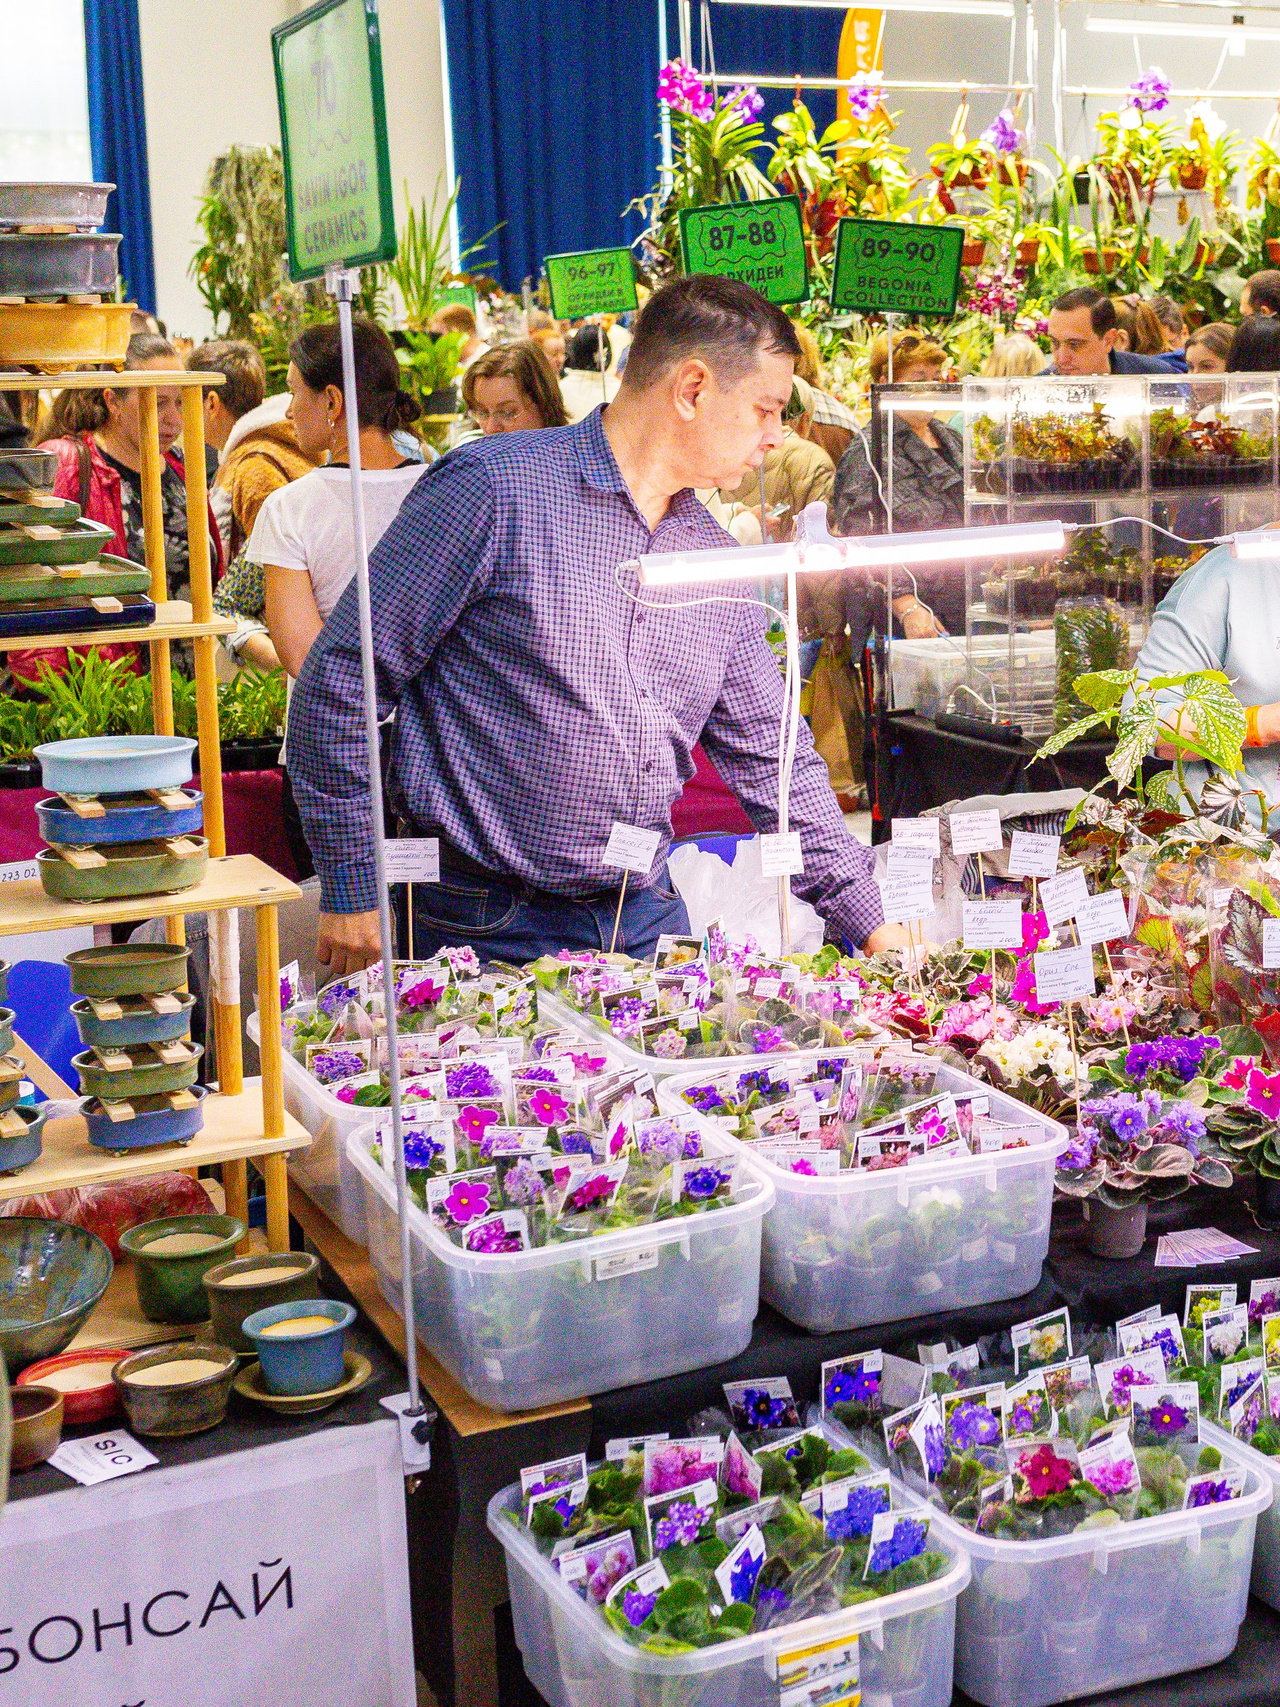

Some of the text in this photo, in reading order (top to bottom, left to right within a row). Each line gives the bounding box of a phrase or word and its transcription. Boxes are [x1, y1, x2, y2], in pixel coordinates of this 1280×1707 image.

[305, 207, 367, 254] CERAMICS
[709, 220, 777, 251] 87-88
[862, 237, 936, 262] 89-90
[568, 262, 615, 281] 96-97
[858, 276, 932, 293] BEGONIA
[843, 289, 949, 309] COLLECTION
[1064, 963, 1079, 973] One
